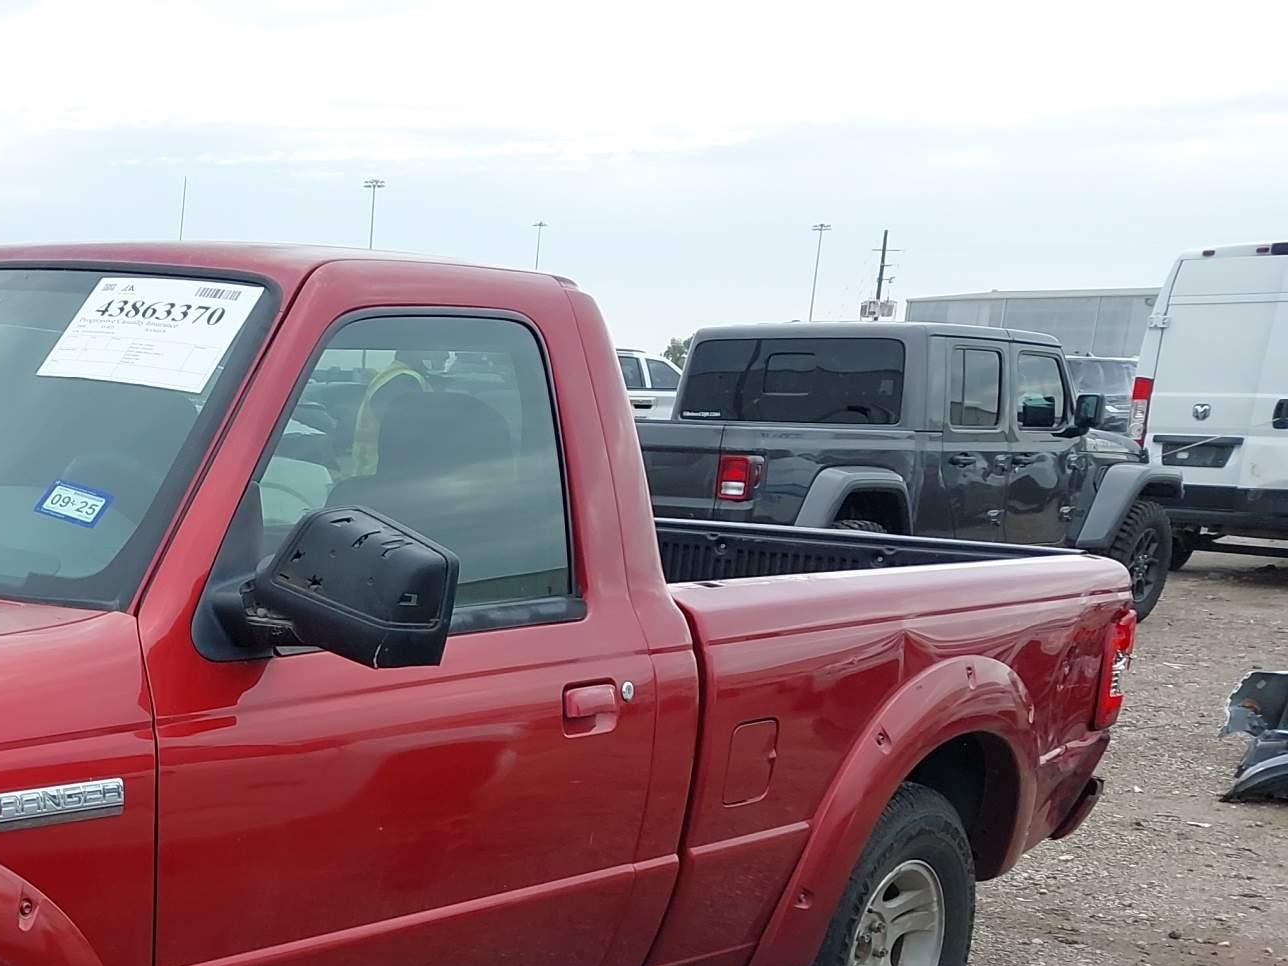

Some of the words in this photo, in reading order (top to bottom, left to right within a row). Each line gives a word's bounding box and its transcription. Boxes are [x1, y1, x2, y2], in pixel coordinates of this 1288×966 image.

[96, 300, 226, 325] 43863370
[50, 493, 72, 508] 09
[74, 500, 99, 516] 25
